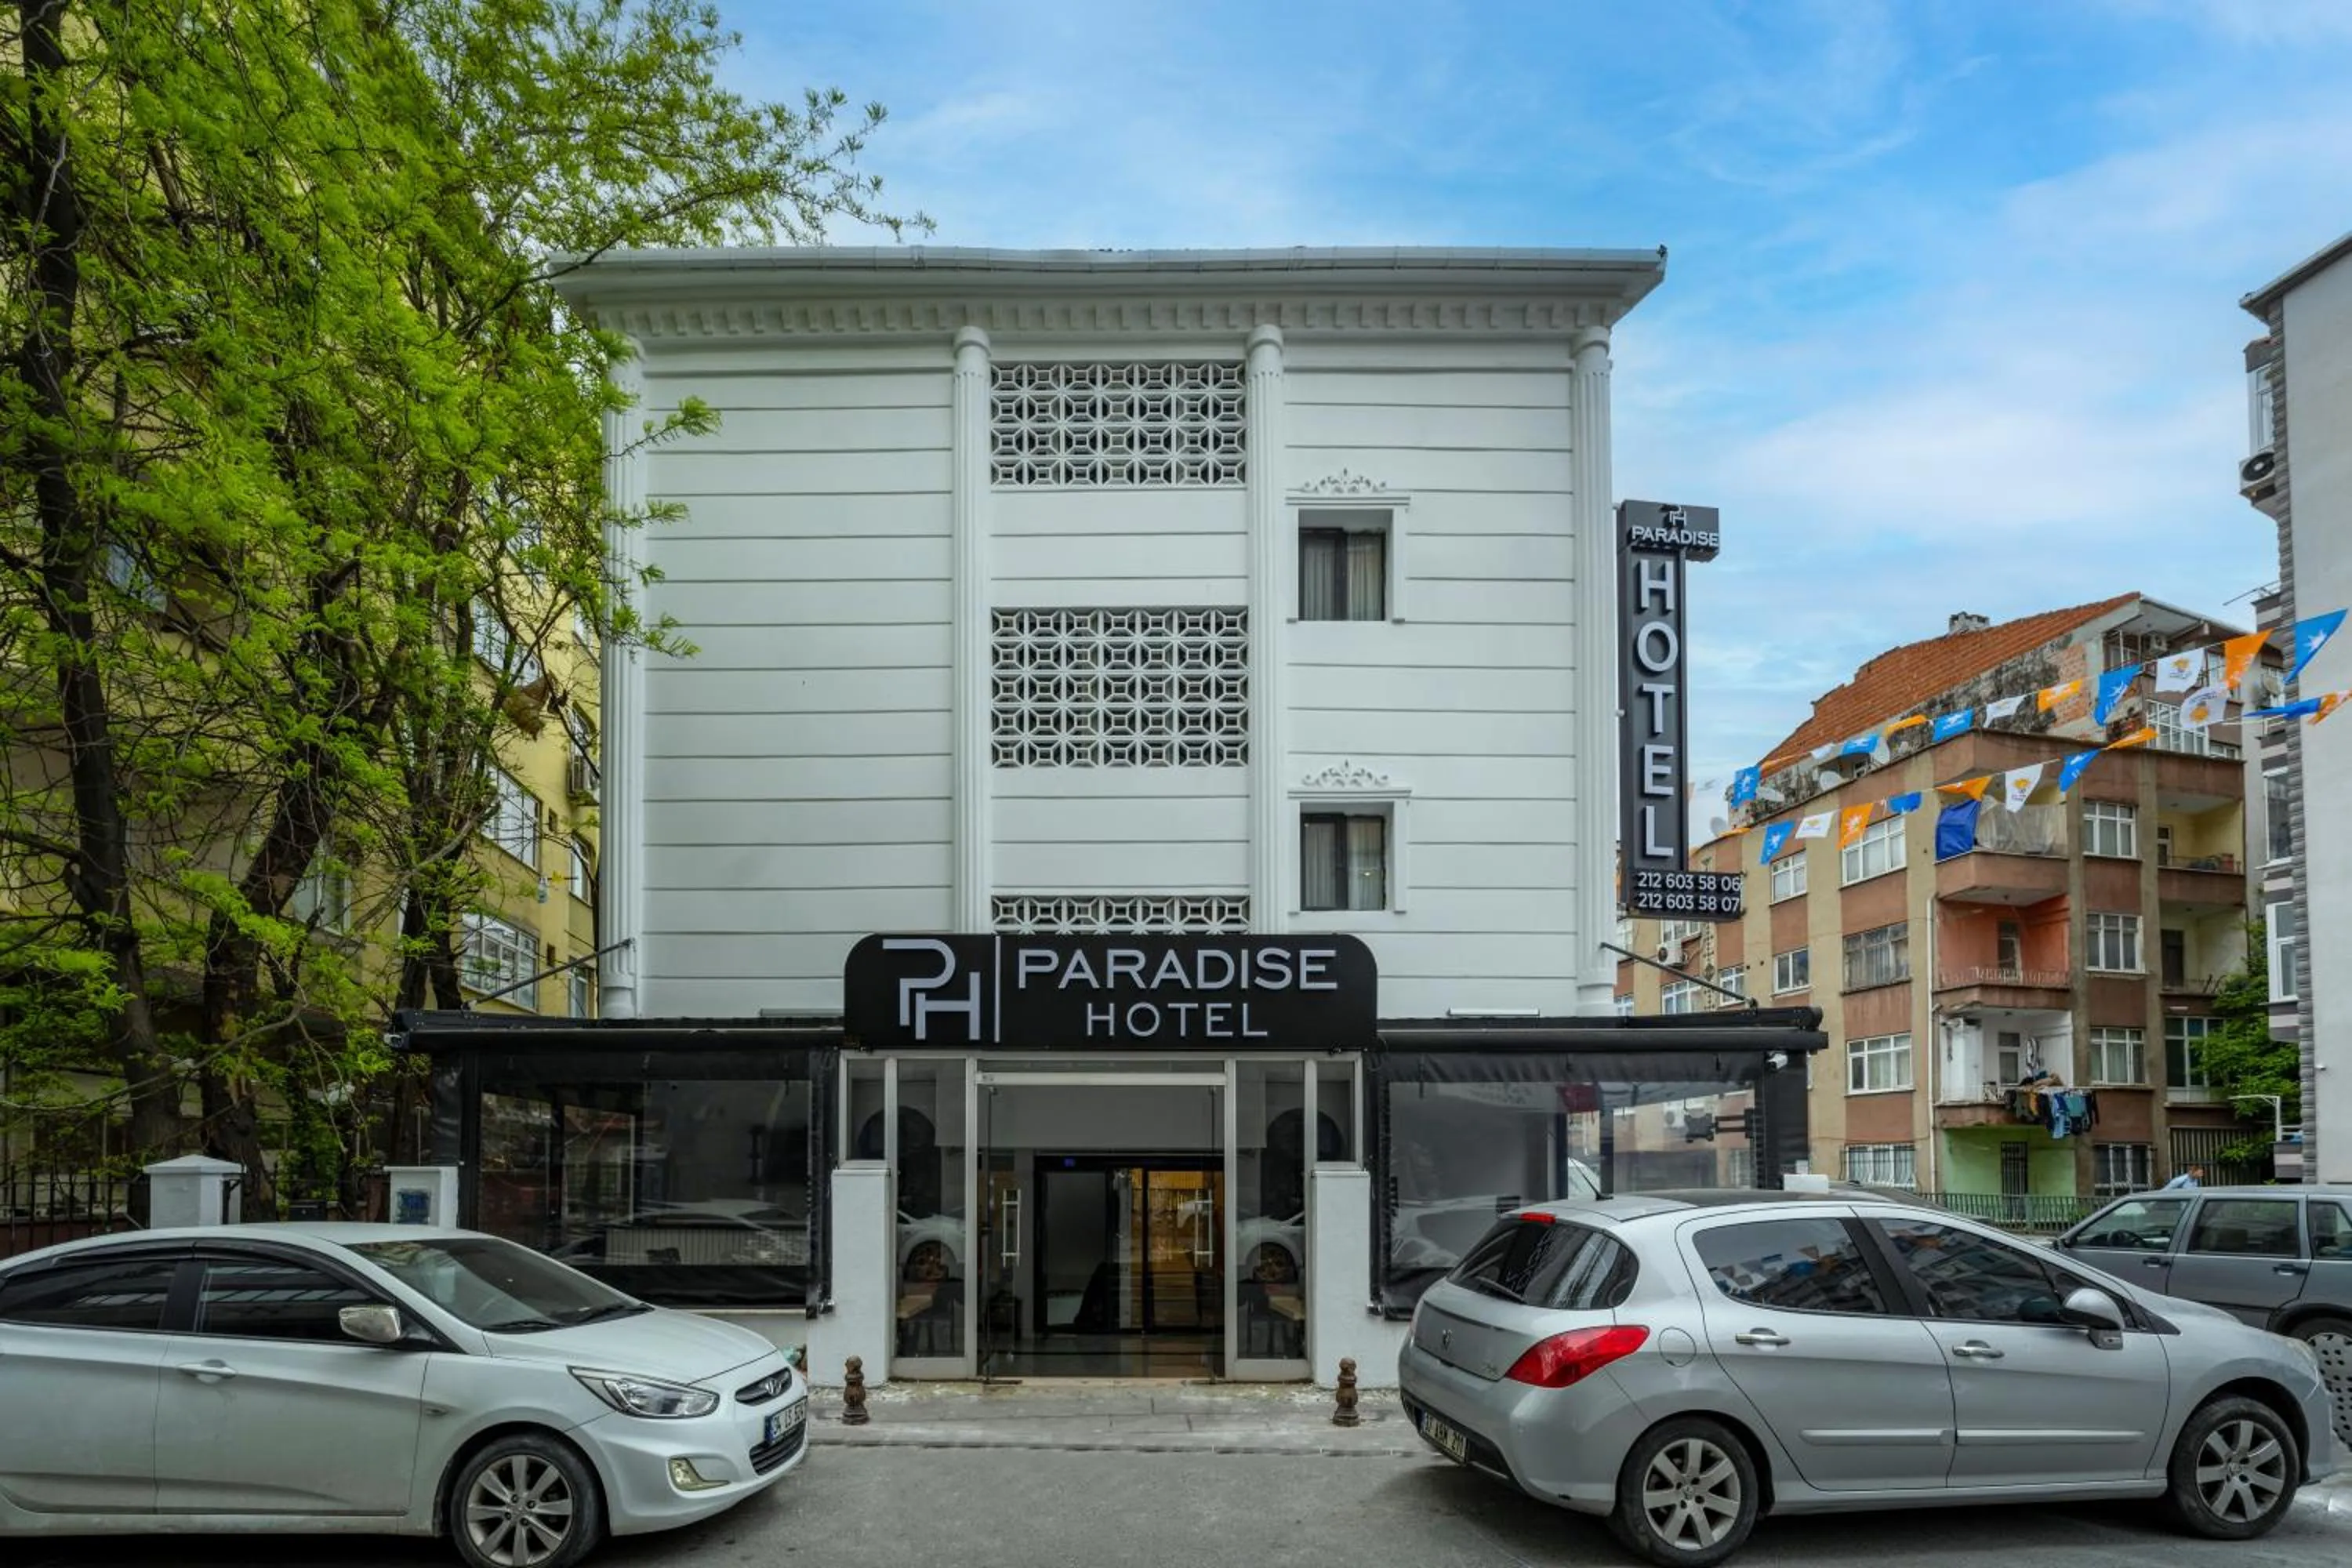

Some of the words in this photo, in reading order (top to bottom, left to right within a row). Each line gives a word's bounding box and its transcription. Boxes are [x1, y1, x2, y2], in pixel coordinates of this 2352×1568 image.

[1632, 526, 1719, 546] PARADISE
[1637, 559, 1679, 858] HOTEL
[1638, 871, 1661, 887] 212
[1666, 873, 1693, 889] 603
[1699, 875, 1716, 890] 58
[1721, 876, 1740, 891] 06
[1638, 892, 1662, 908] 212
[1666, 893, 1693, 909] 603
[1699, 895, 1717, 910] 58
[1721, 896, 1740, 912] 07
[1018, 949, 1338, 989] PARADISE
[1087, 1002, 1268, 1037] HOTEL
